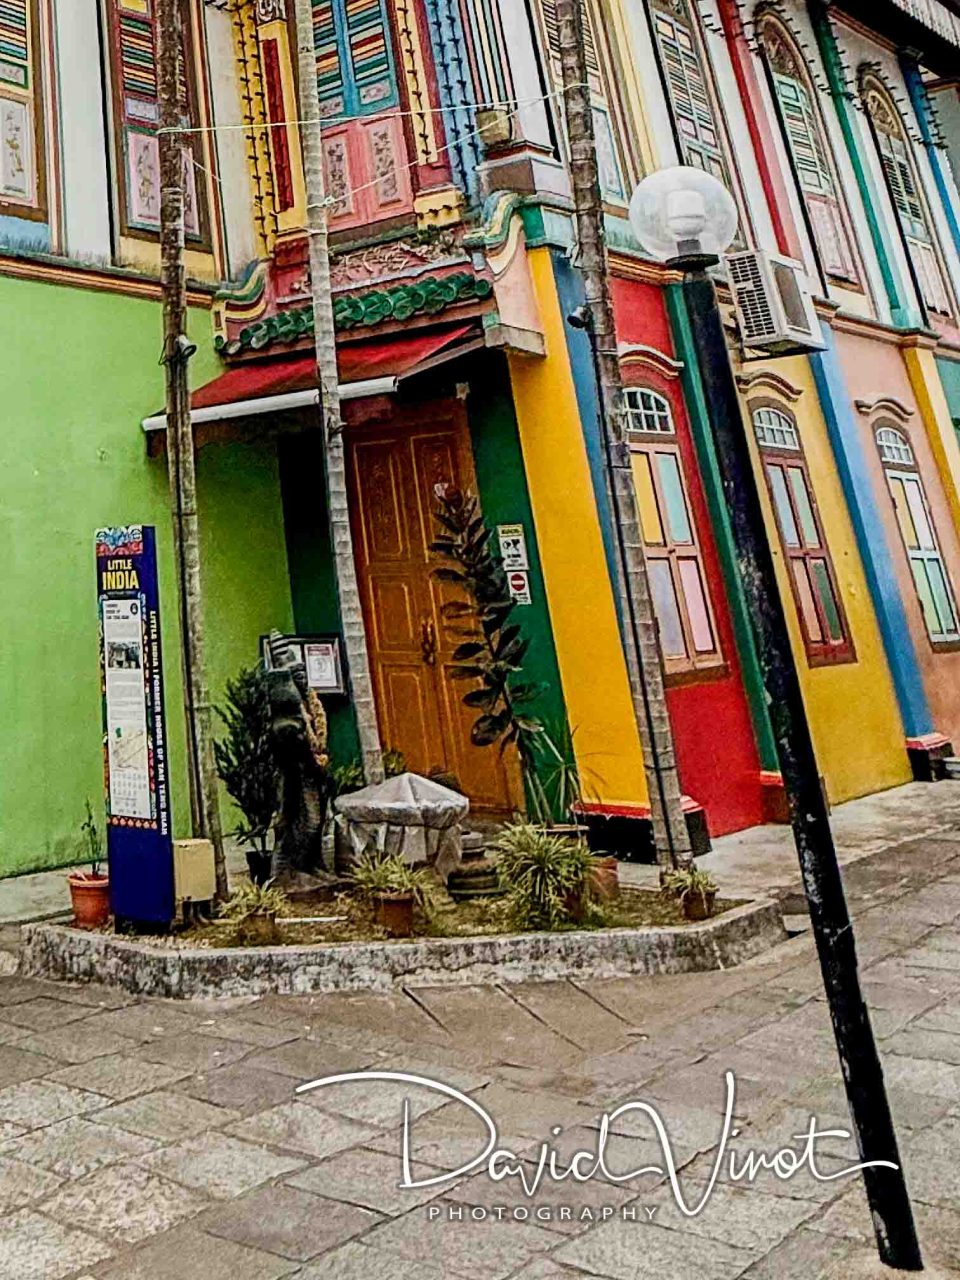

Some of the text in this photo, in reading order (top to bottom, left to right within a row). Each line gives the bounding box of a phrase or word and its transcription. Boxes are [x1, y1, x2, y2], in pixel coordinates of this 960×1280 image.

[107, 559, 132, 570] LITTLE
[102, 570, 139, 590] INDIA
[156, 747, 164, 761] OF
